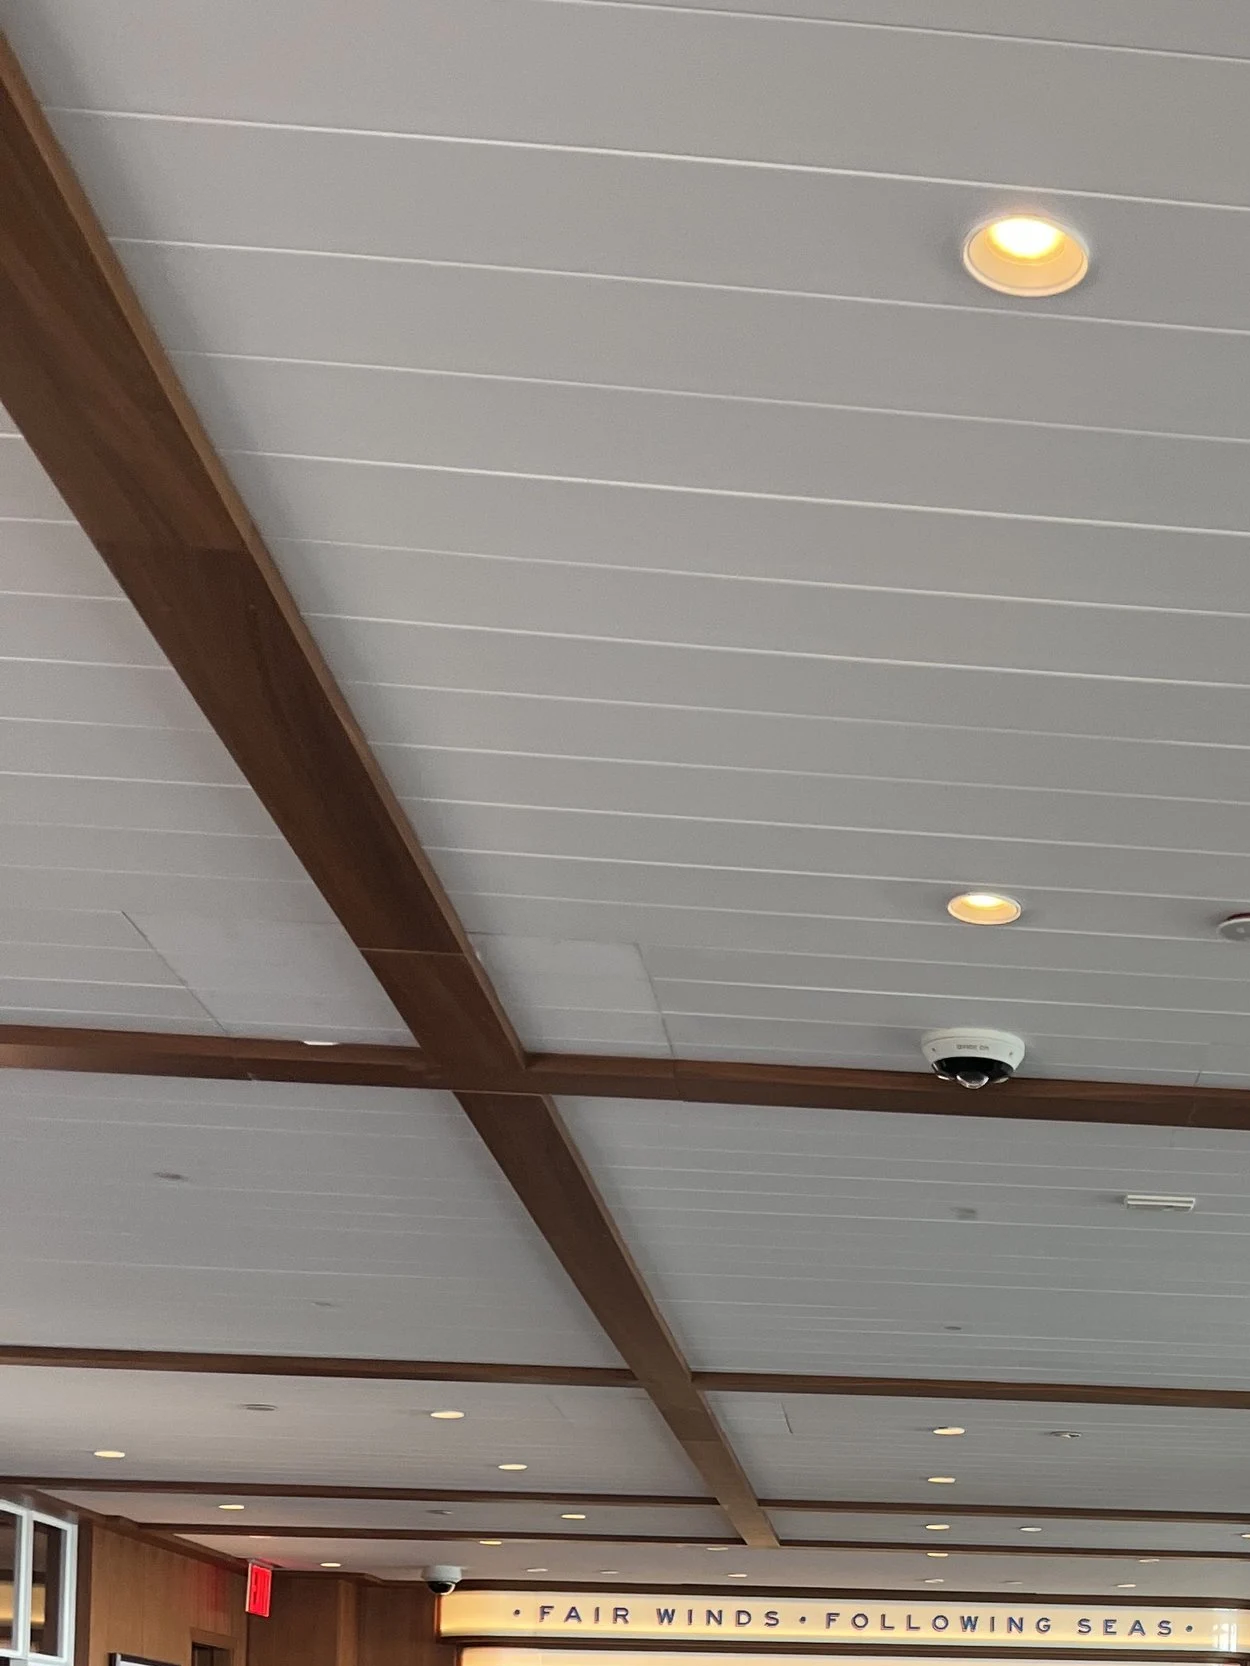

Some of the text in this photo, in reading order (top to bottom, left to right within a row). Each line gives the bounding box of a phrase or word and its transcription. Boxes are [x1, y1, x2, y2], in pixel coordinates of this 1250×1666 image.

[538, 1605, 1172, 1636] FAIR WINDS FOLLOWING SEAS
